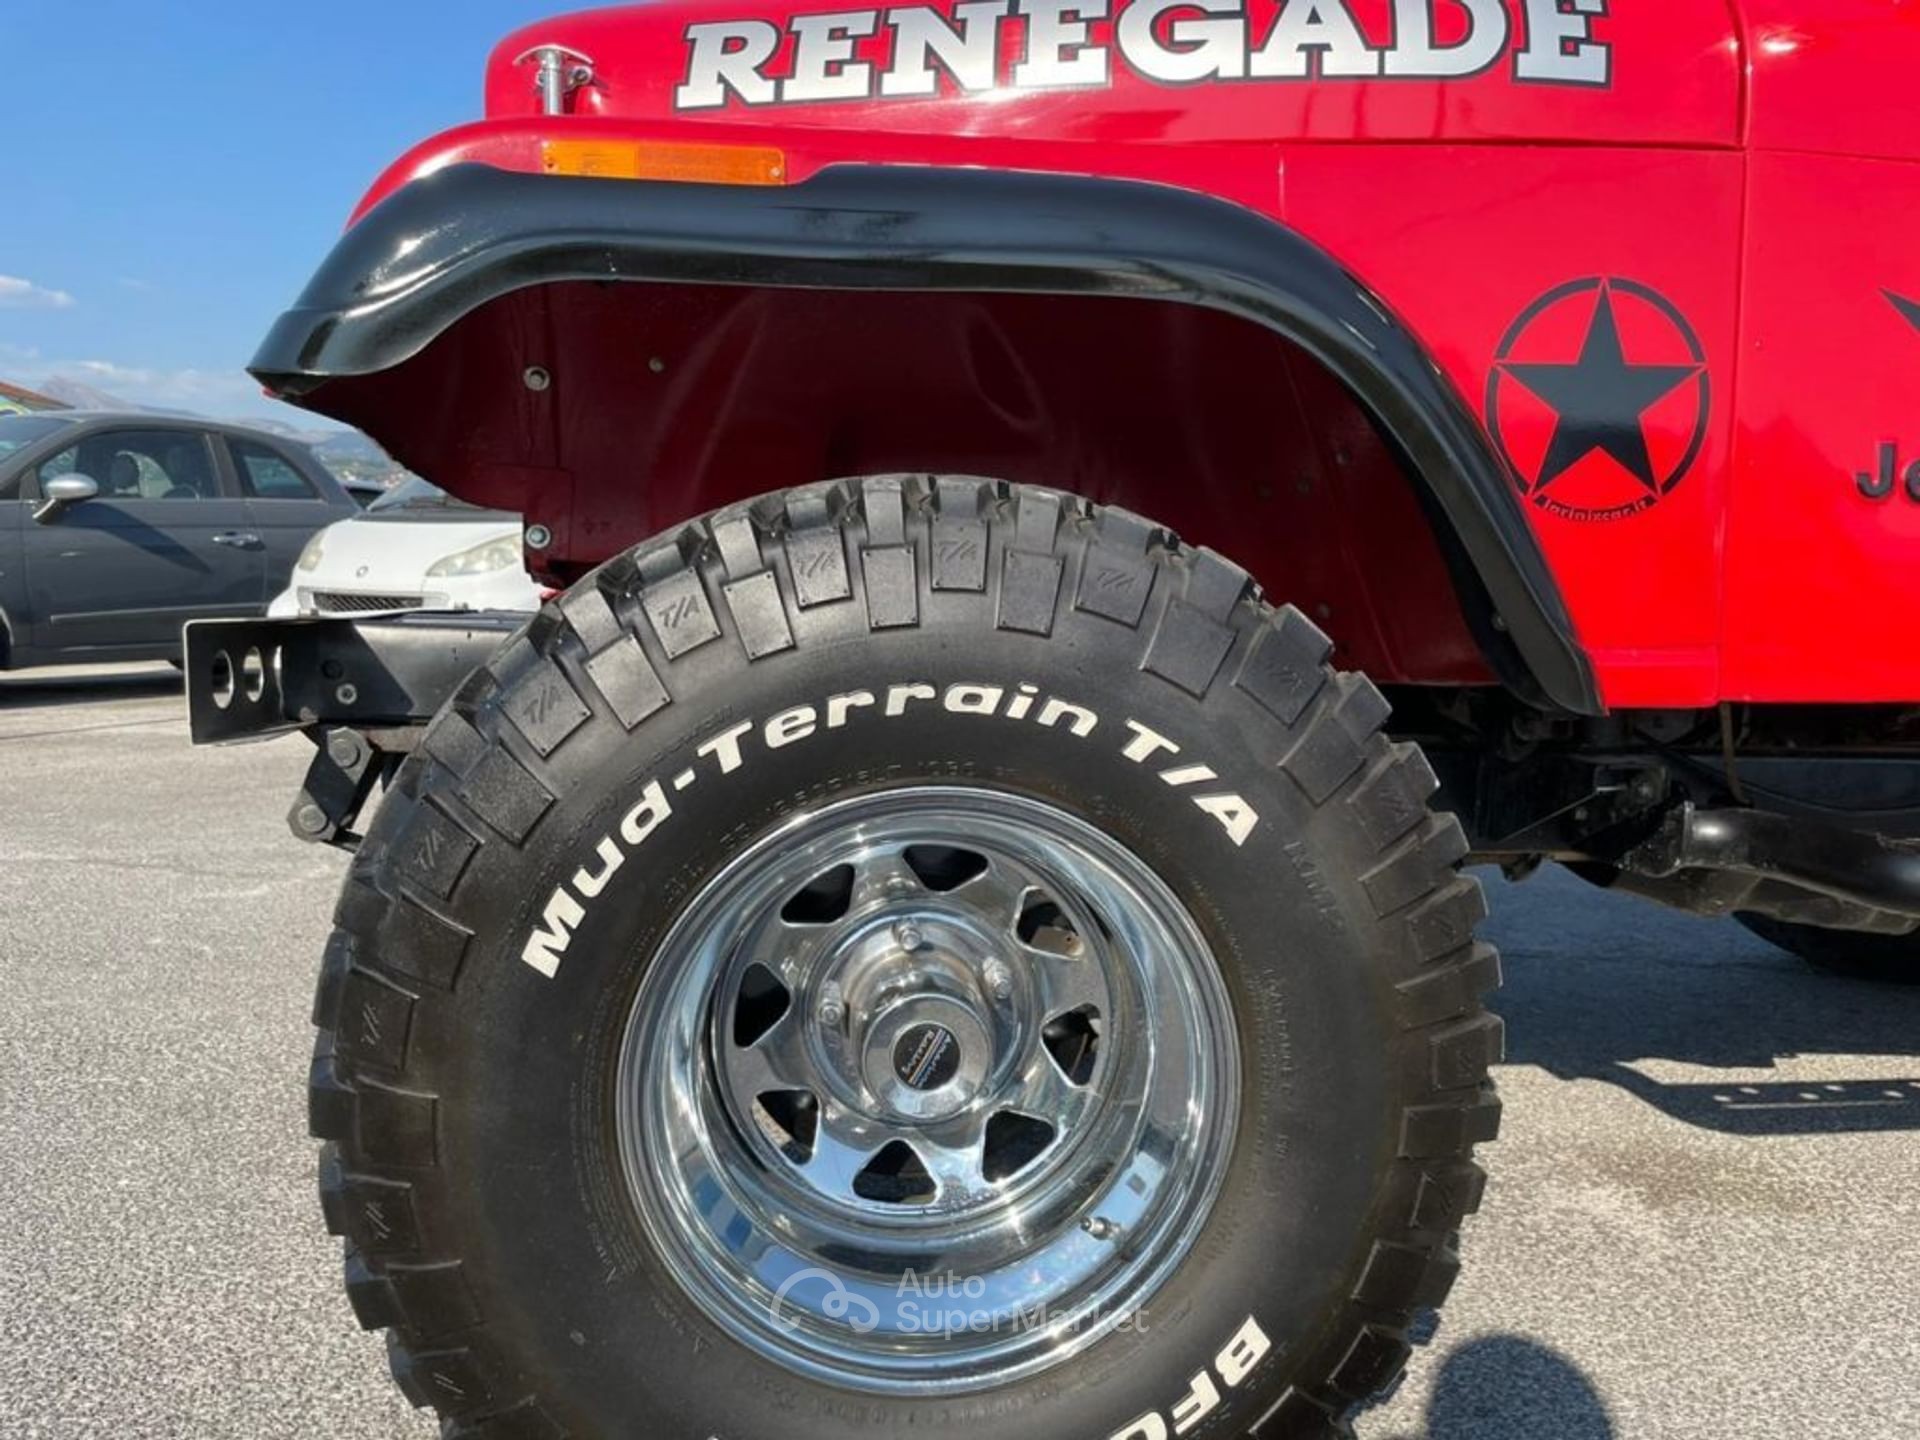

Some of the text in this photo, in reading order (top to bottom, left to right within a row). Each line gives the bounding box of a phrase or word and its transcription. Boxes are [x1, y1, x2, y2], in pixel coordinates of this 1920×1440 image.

[674, 0, 1612, 111] RENEGADE
[521, 675, 1099, 979] Mud-Terrain
[1121, 718, 1260, 847] T/A
